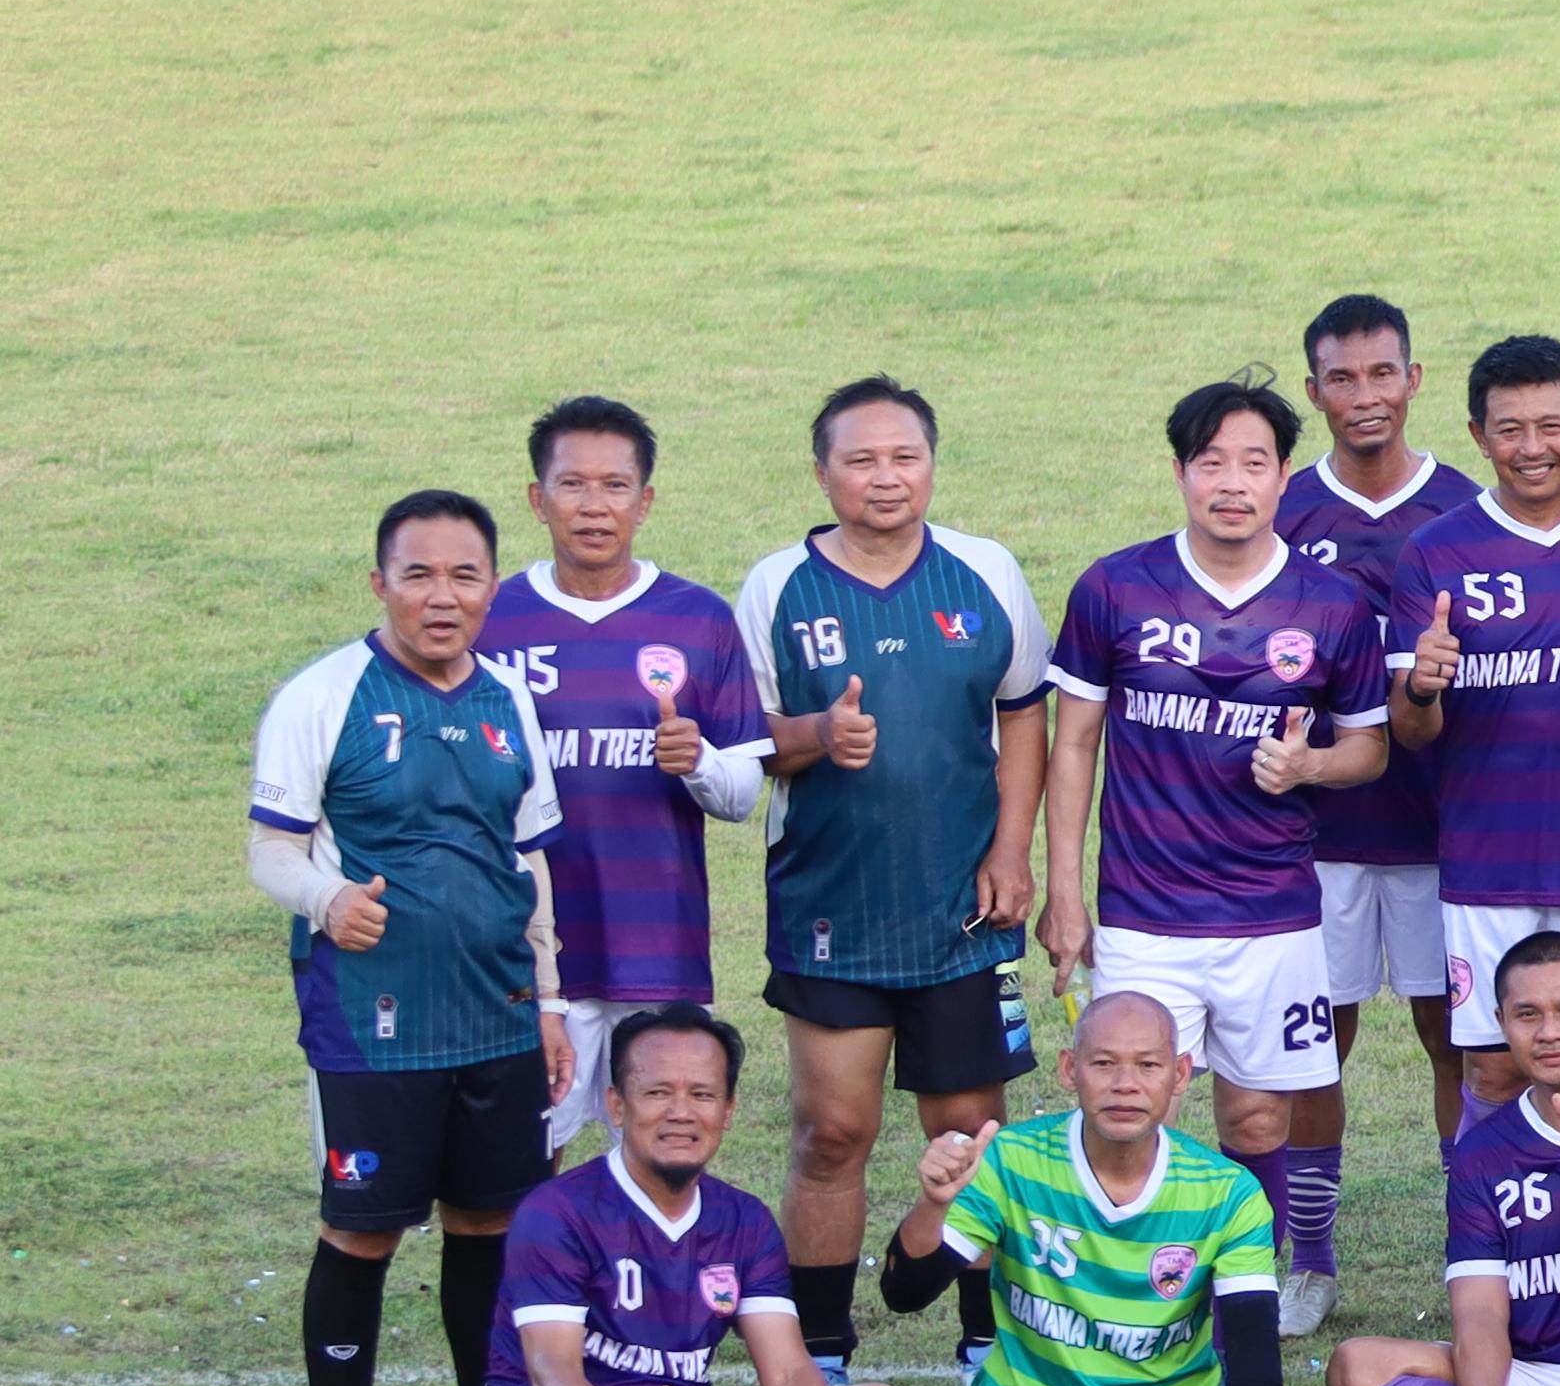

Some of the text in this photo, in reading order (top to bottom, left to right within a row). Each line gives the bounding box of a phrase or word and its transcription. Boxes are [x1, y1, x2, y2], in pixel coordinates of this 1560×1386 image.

[1463, 572, 1526, 621] 53
[793, 616, 847, 670] 18
[1138, 617, 1201, 667] 29
[373, 712, 403, 764] 7
[1124, 686, 1211, 734] BANANA
[1214, 699, 1283, 739] TREE
[589, 727, 657, 770] TREE
[1283, 994, 1333, 1052] 29
[1495, 1171, 1552, 1231] 26
[1028, 1218, 1083, 1280] 35
[1009, 1284, 1089, 1349] BANANA
[1094, 1319, 1162, 1362] TREE
